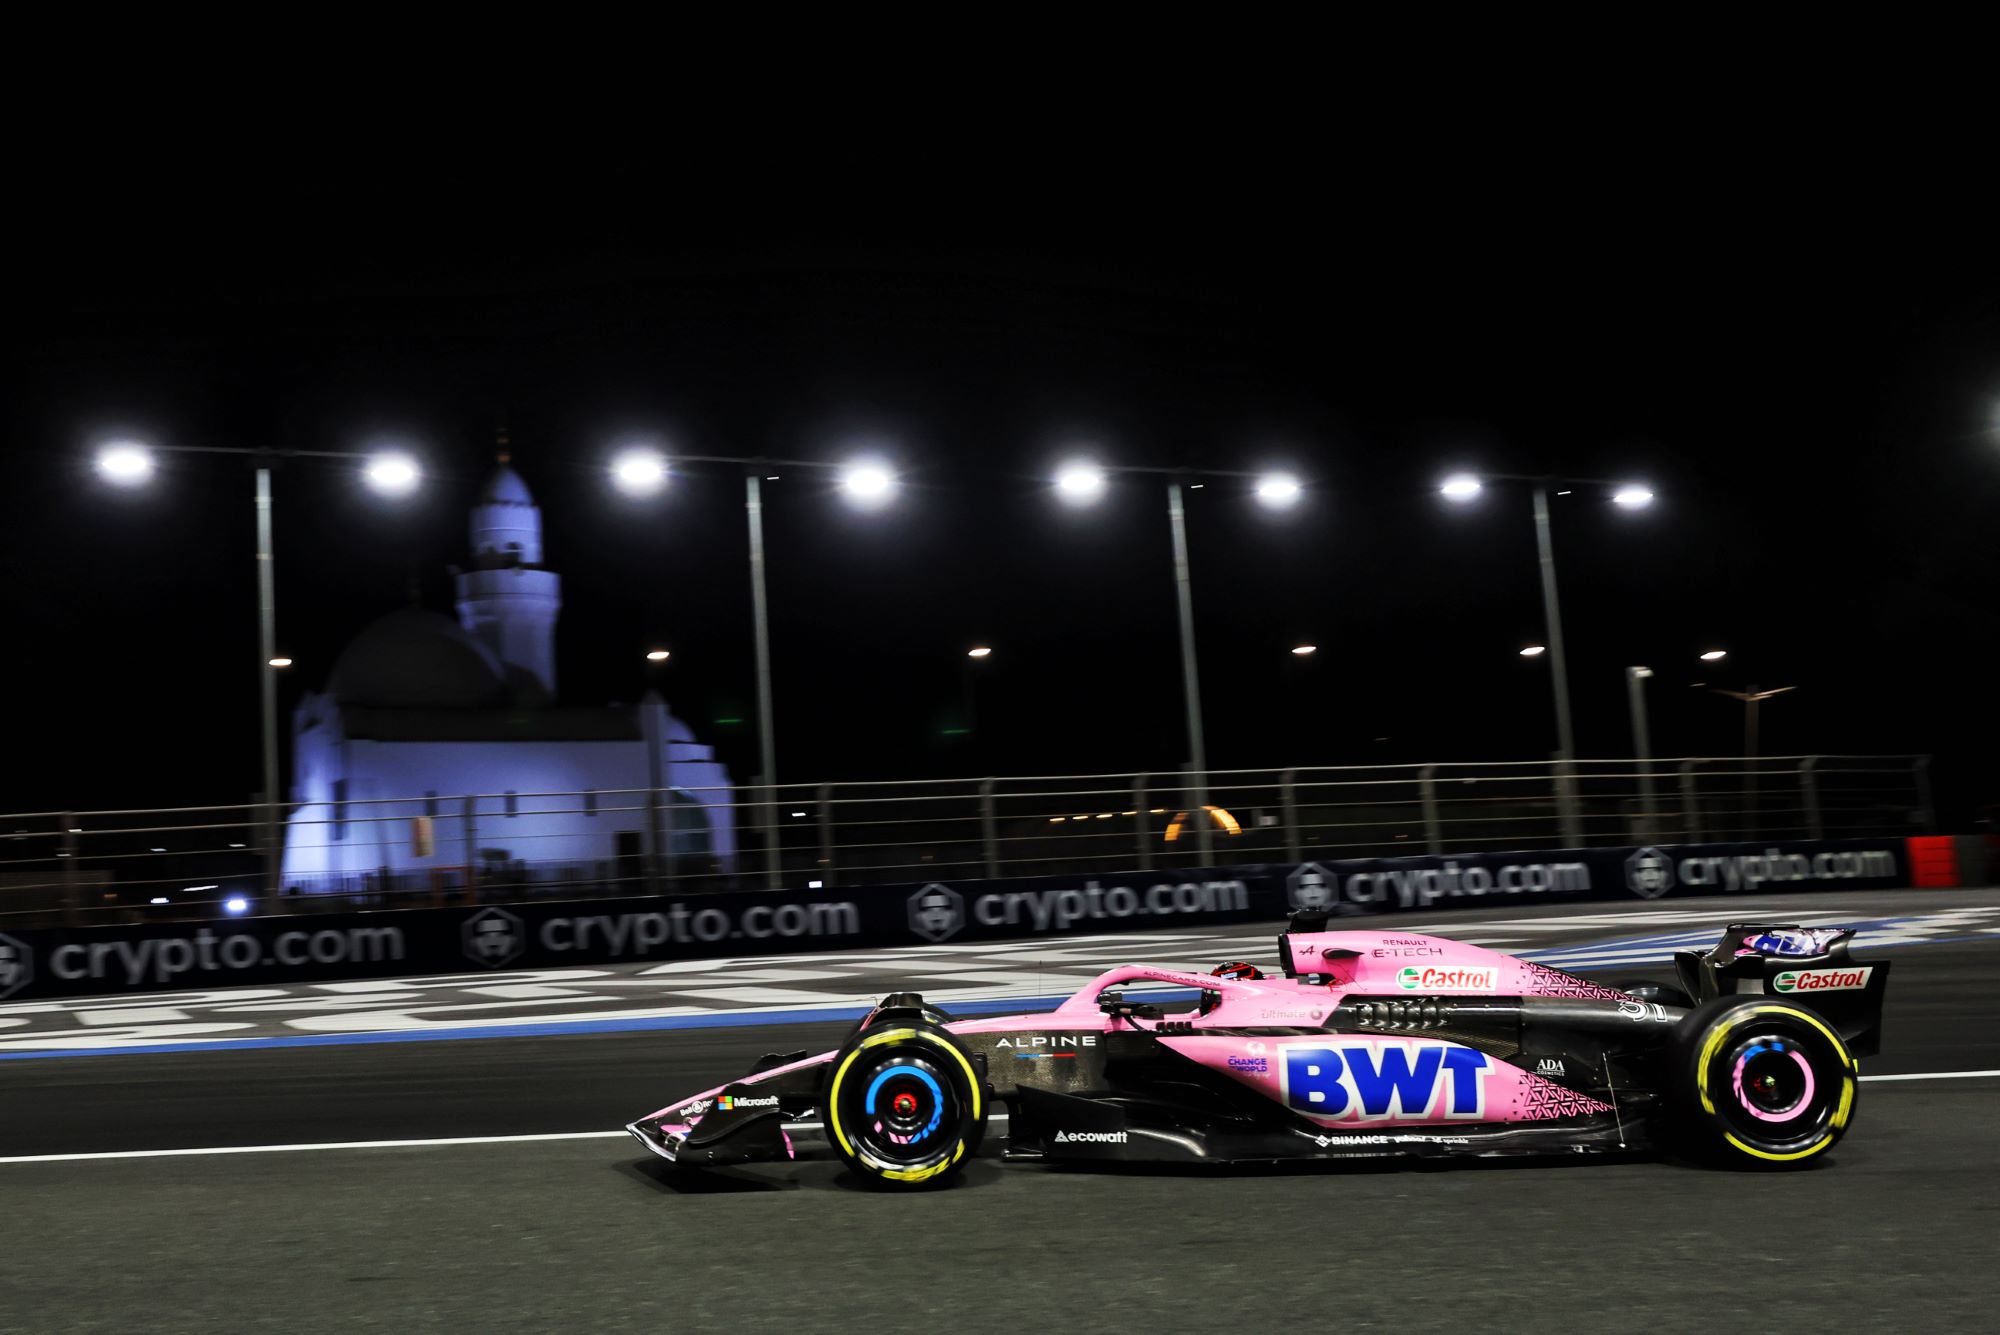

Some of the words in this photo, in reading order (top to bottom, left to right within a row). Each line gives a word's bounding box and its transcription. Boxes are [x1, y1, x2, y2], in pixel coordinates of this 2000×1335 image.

[1678, 849, 1896, 891] crypto.com
[1346, 859, 1592, 908] crypto.com
[982, 878, 1249, 930] crypto.com
[540, 902, 860, 957] crypto.com
[49, 926, 405, 986] crypto.com
[1143, 970, 1221, 988] ALPINECARS.COM
[1421, 968, 1492, 989] Castrol
[1796, 970, 1865, 990] Castrol
[996, 1036, 1096, 1048] ALPINE
[1537, 1058, 1564, 1071] ADA
[1286, 1046, 1488, 1116] BWT
[734, 1095, 779, 1107] Microsoft
[1068, 1131, 1127, 1143] ecowatt
[1332, 1135, 1388, 1145] BINANCE
